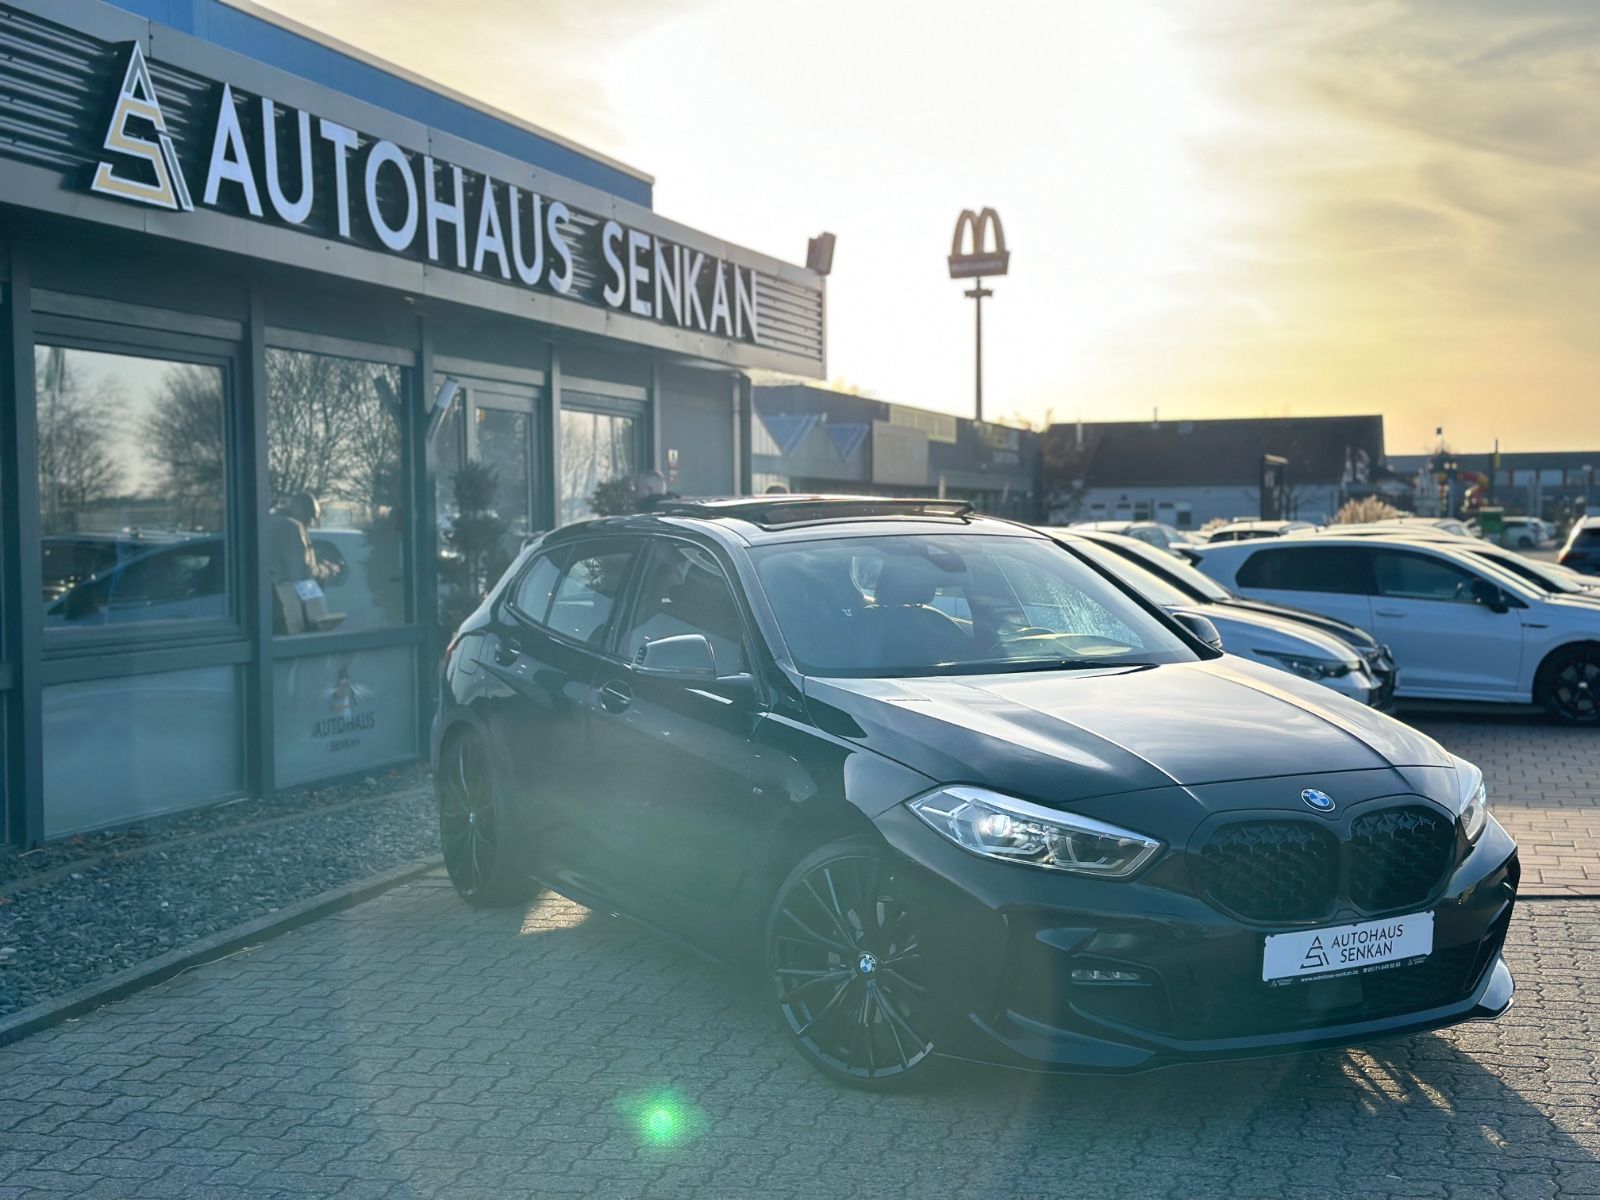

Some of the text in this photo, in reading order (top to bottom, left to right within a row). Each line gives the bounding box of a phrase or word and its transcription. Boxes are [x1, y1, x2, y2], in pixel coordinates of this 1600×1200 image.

[203, 82, 758, 343] AUTOHAUS SENKAN
[311, 711, 376, 739] AUTOHAUS
[1331, 924, 1404, 949] AUTOHAUS
[1339, 941, 1393, 963] SENKAN
